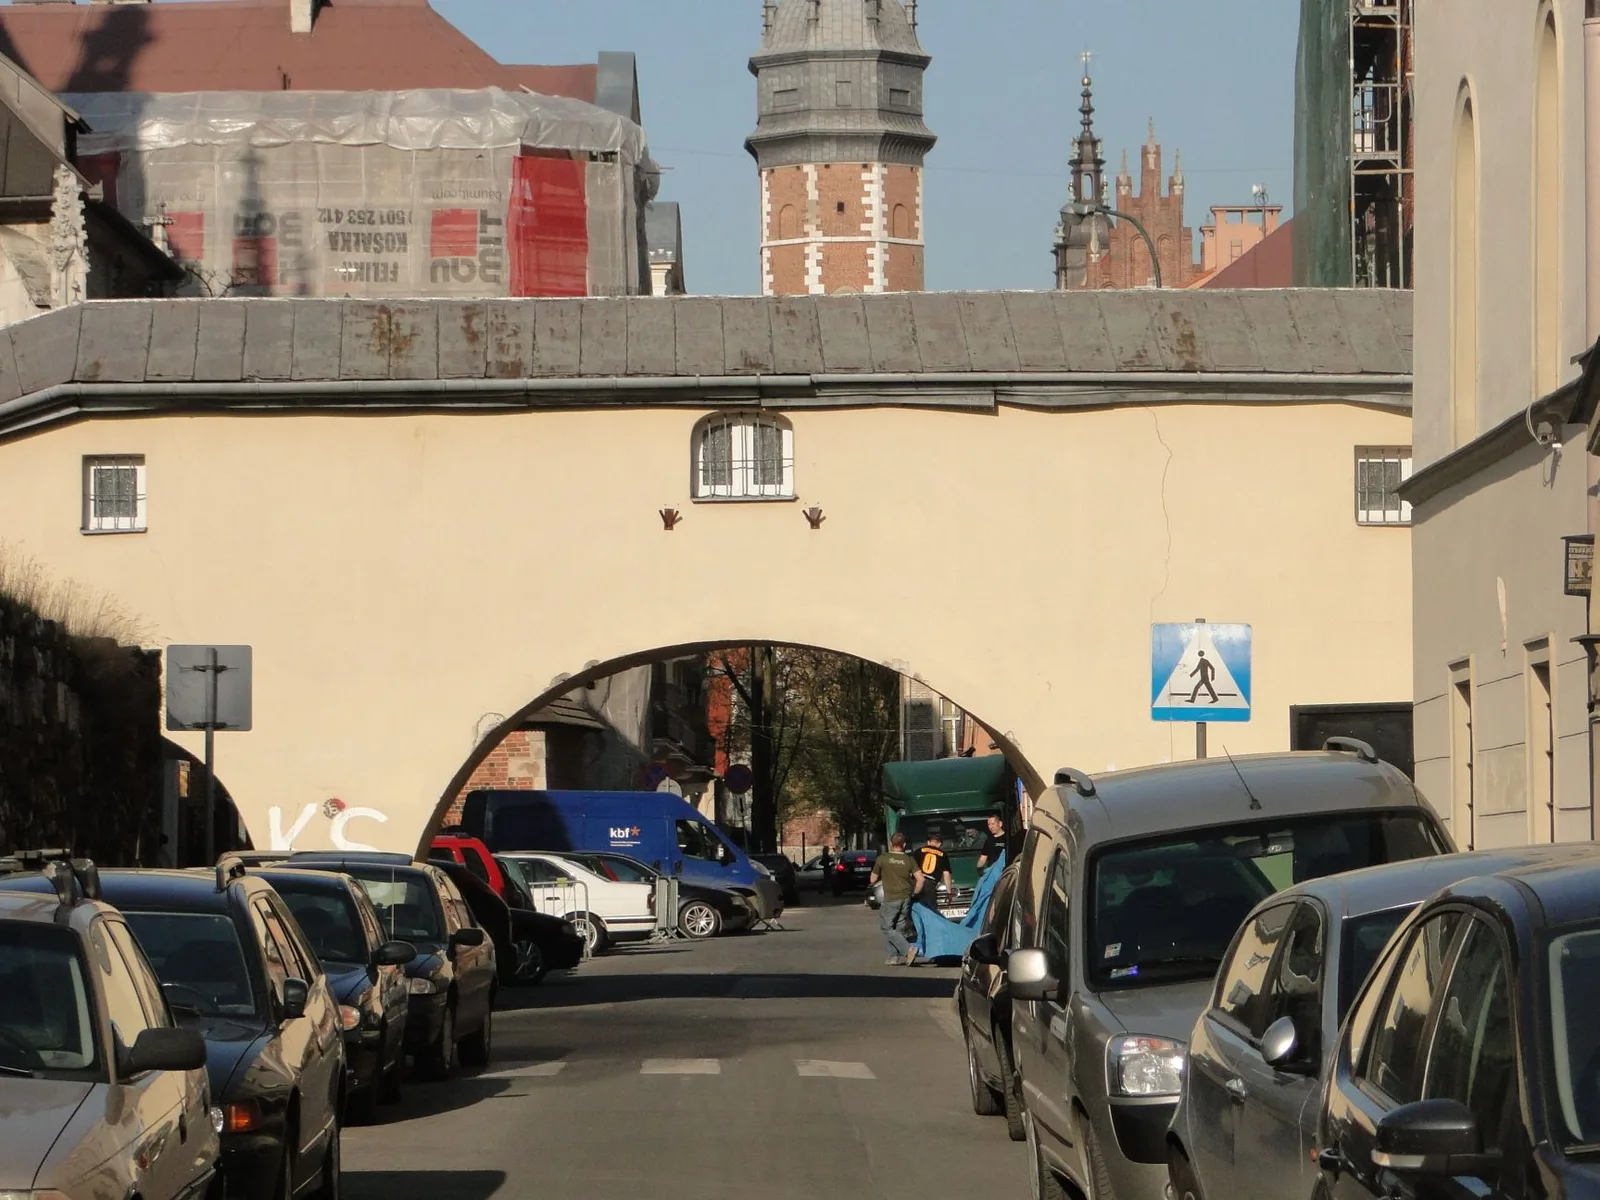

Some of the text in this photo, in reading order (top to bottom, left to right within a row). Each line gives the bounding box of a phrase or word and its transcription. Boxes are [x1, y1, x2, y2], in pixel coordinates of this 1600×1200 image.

[317, 208, 343, 223] 412
[347, 210, 376, 225] 253
[379, 210, 406, 225] 501
